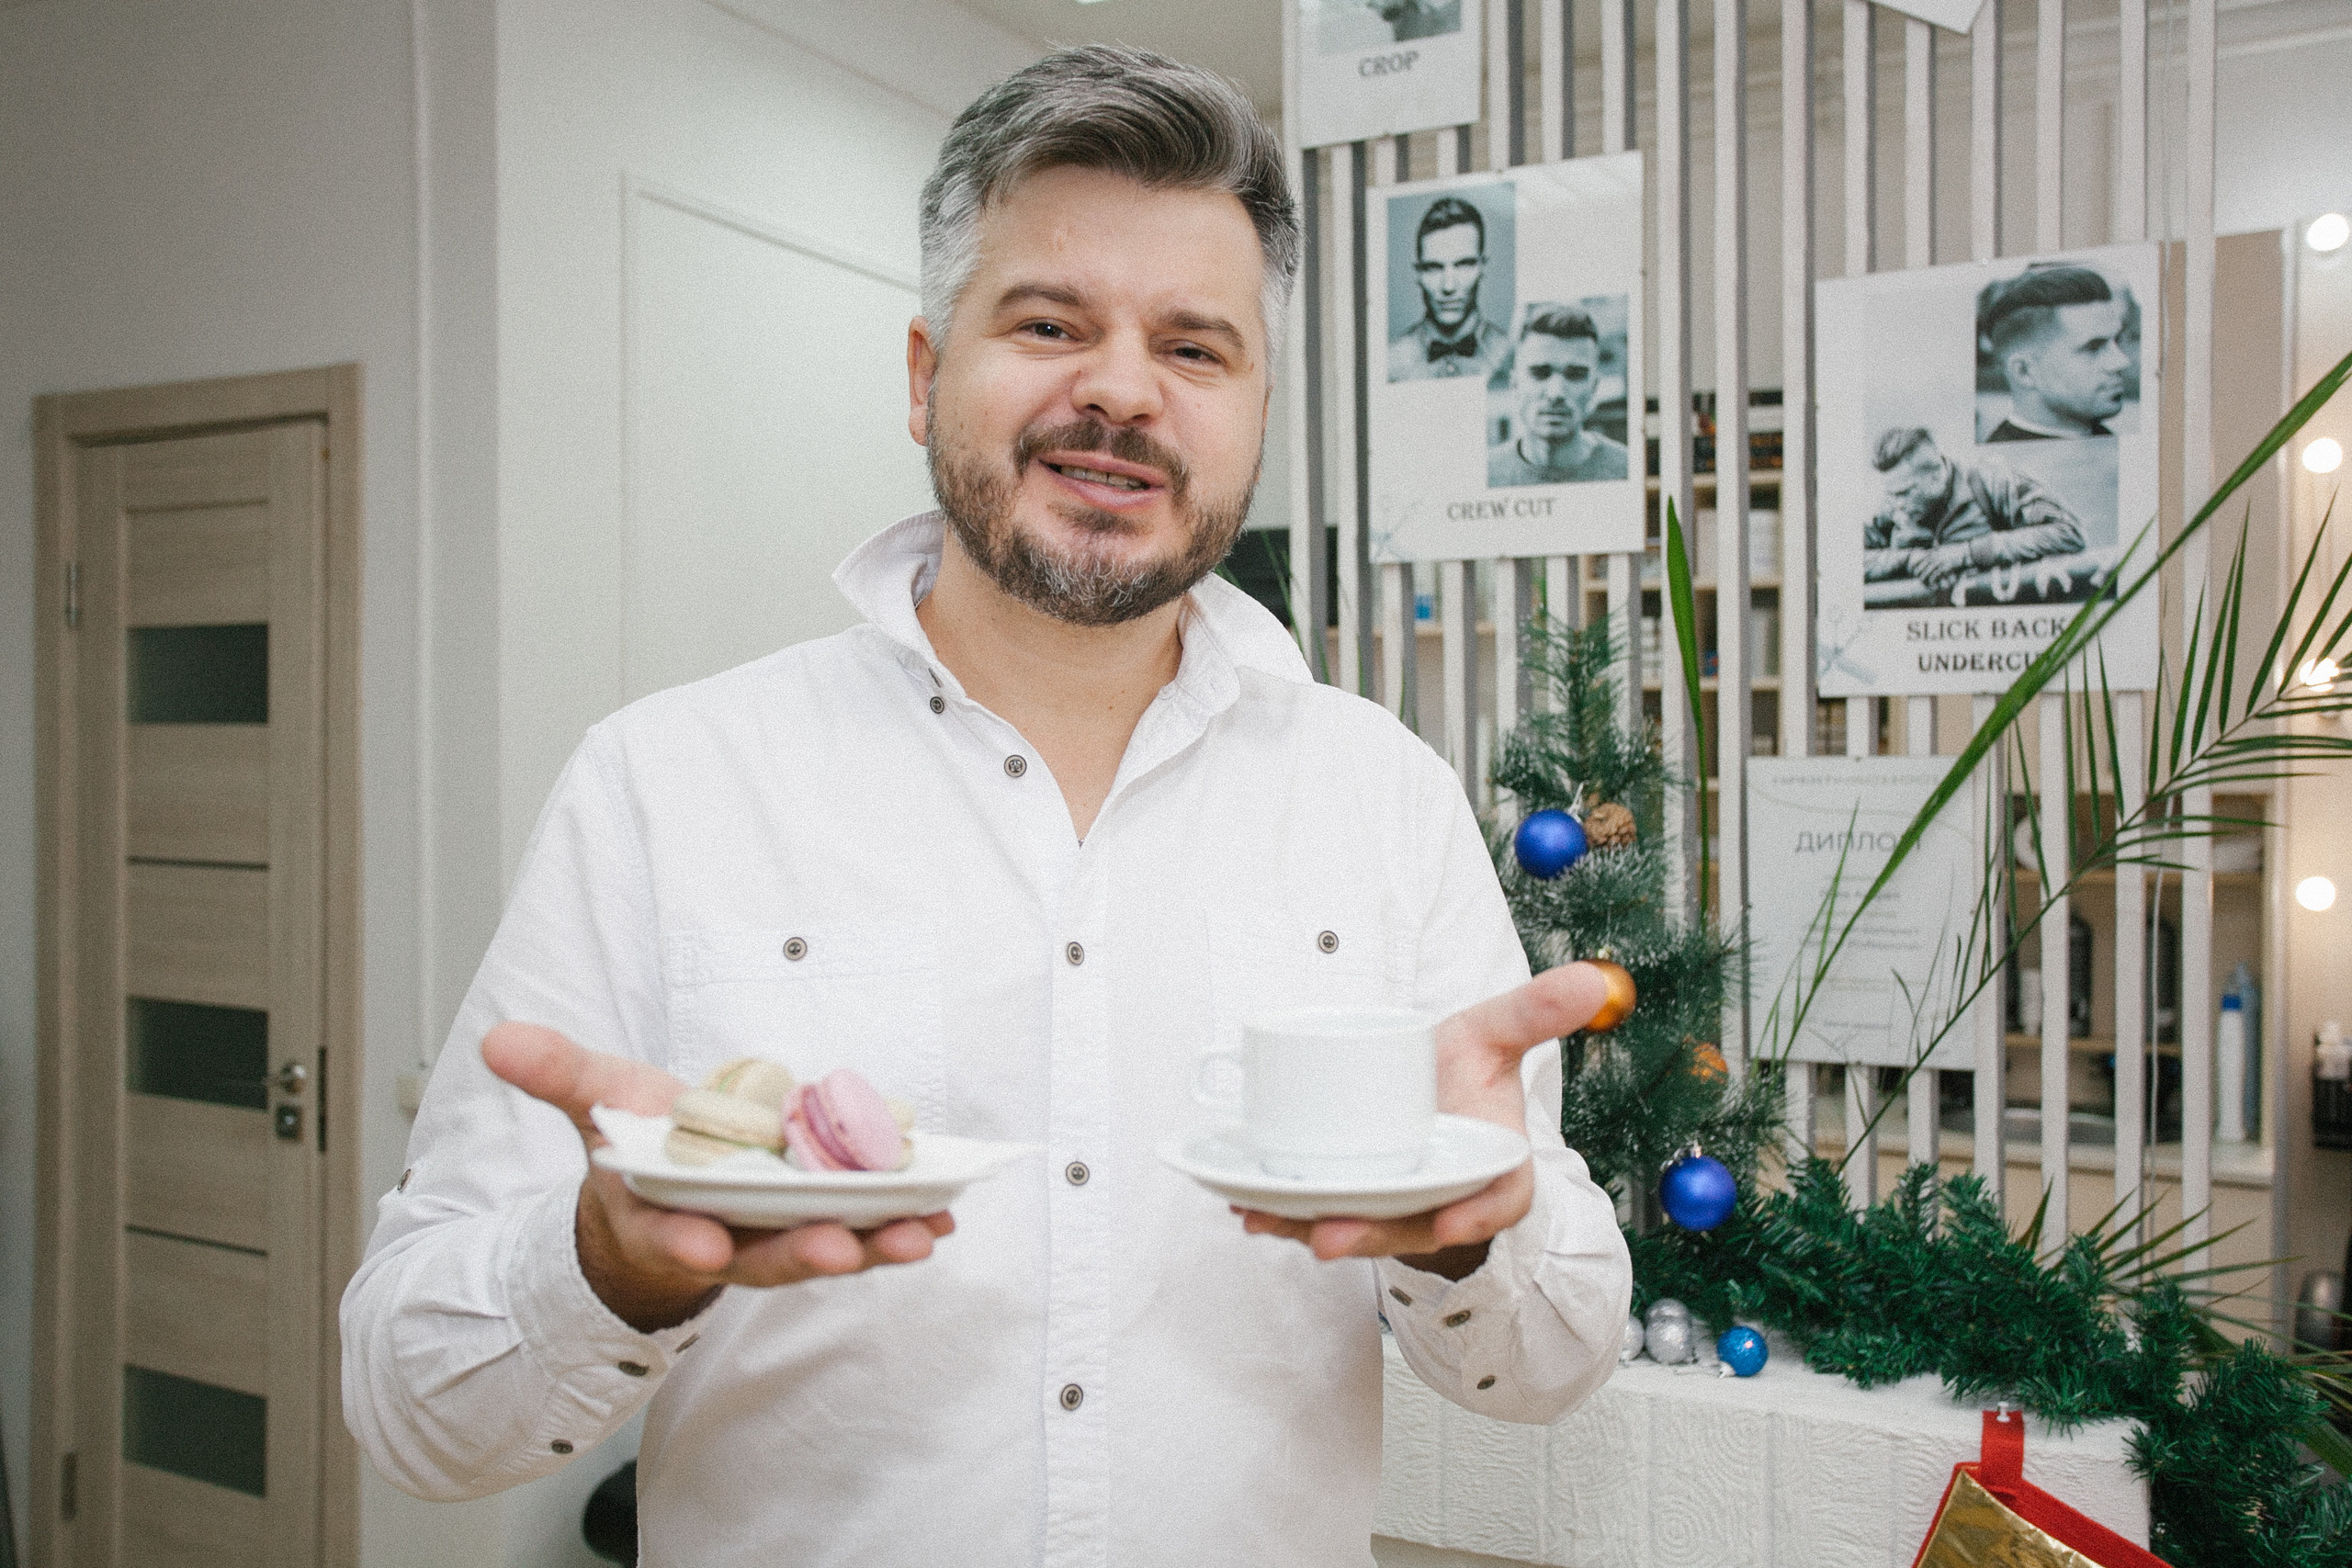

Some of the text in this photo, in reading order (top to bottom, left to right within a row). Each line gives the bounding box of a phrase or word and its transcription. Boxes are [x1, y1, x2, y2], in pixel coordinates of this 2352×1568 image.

[1358, 51, 1419, 76] CROP
[1447, 496, 1558, 521] CREW CUT
[1906, 617, 2066, 641] SLICK BACK
[1918, 651, 2060, 672] UNDERCU
[1795, 831, 1921, 853] ДИПЛО
